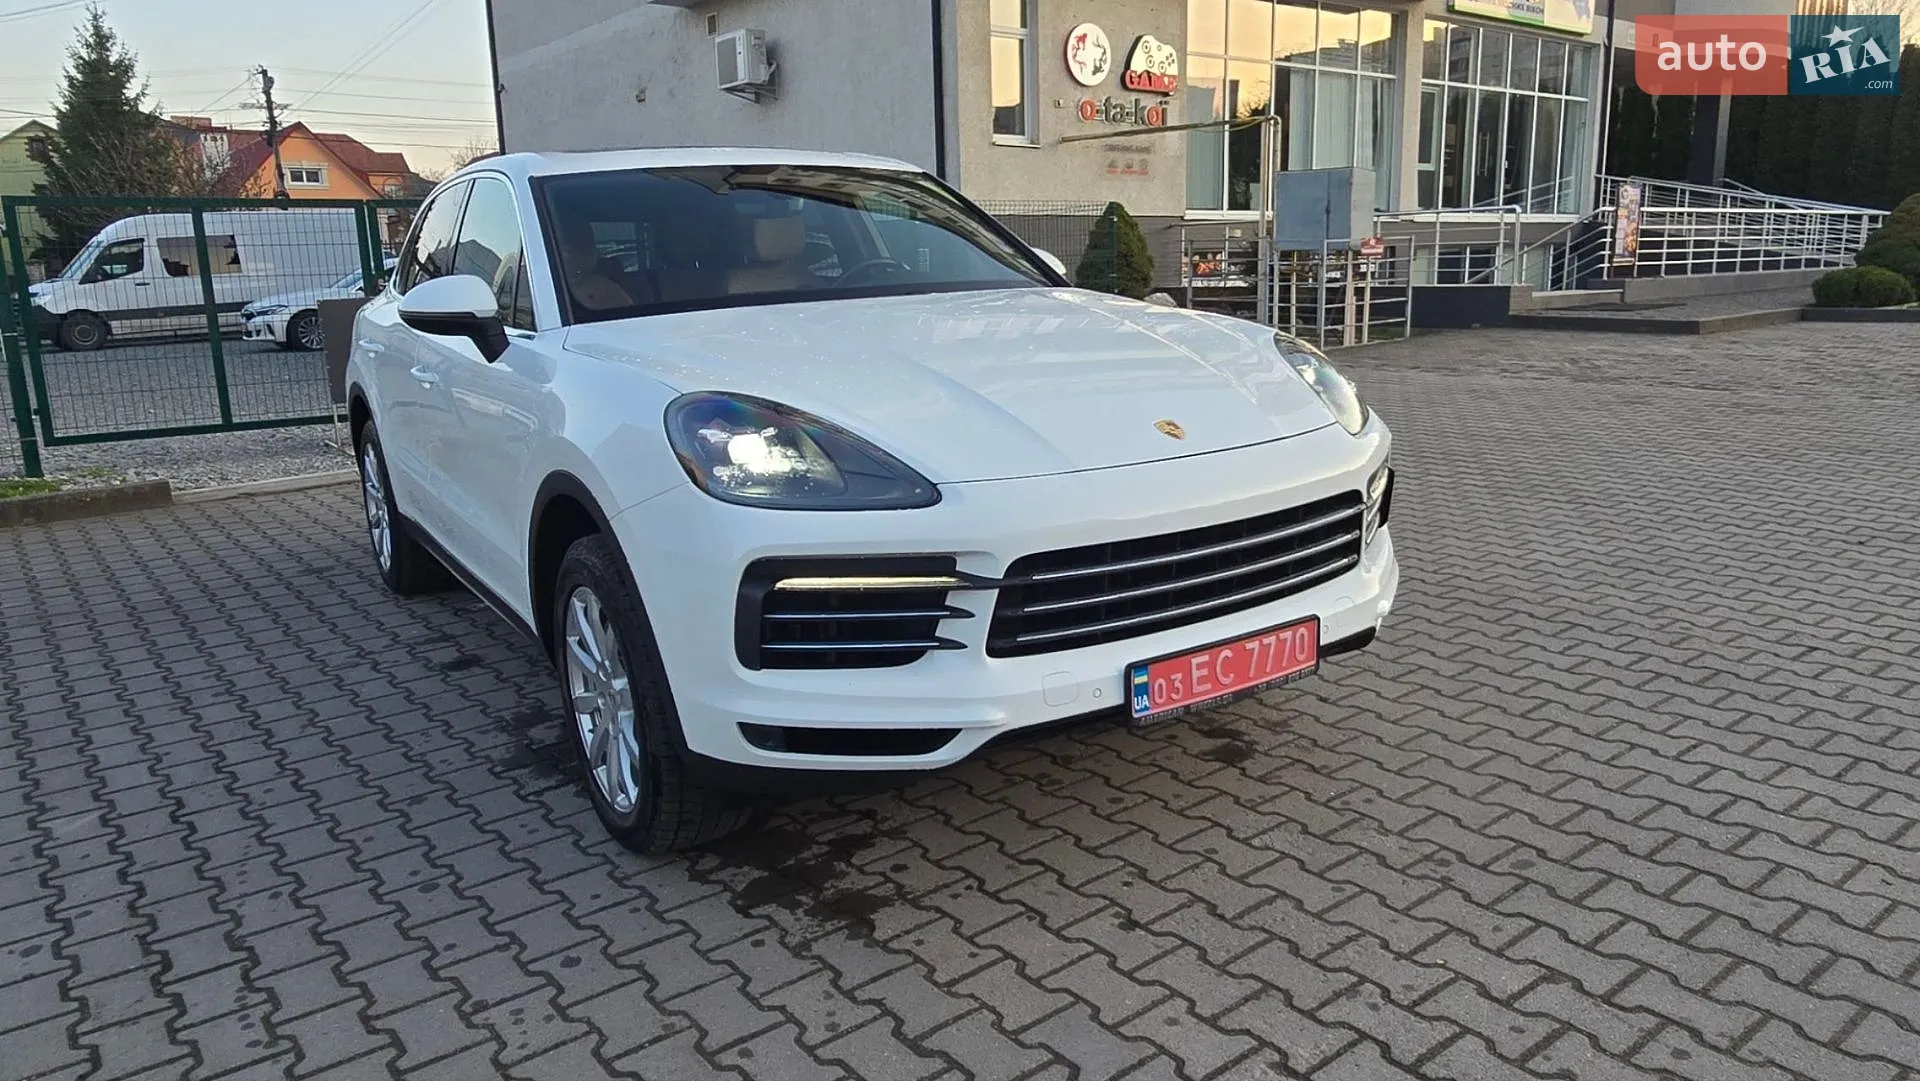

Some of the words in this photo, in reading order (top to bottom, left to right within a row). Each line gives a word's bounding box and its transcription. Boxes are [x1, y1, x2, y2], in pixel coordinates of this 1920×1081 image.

[1154, 673, 1184, 704] 03
[1191, 649, 1235, 694] EC
[1244, 627, 1309, 678] 7770
[1134, 694, 1150, 710] UA
